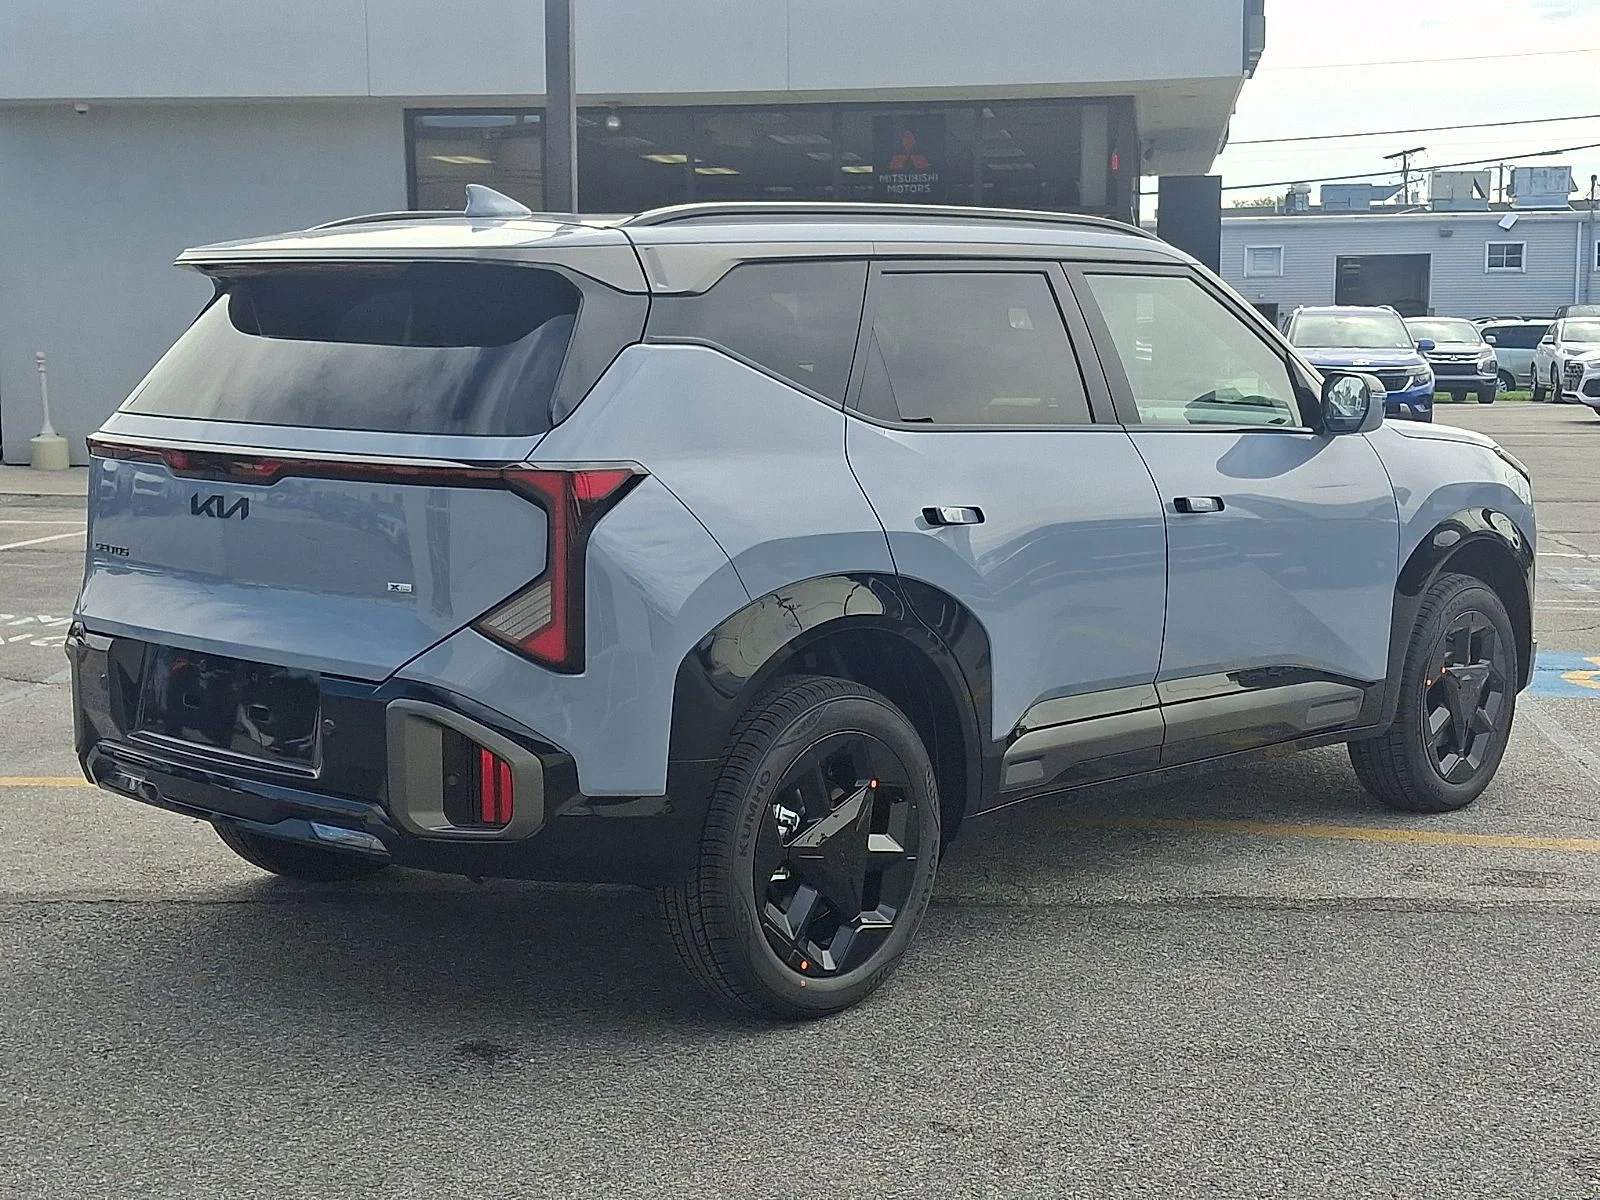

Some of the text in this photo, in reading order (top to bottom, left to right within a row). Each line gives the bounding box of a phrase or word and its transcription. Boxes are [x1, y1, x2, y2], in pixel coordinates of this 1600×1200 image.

[879, 173, 939, 184] MITSUBISHI
[887, 184, 931, 193] MOTORS
[190, 491, 250, 521] KIA
[737, 769, 772, 858] KUMHO
